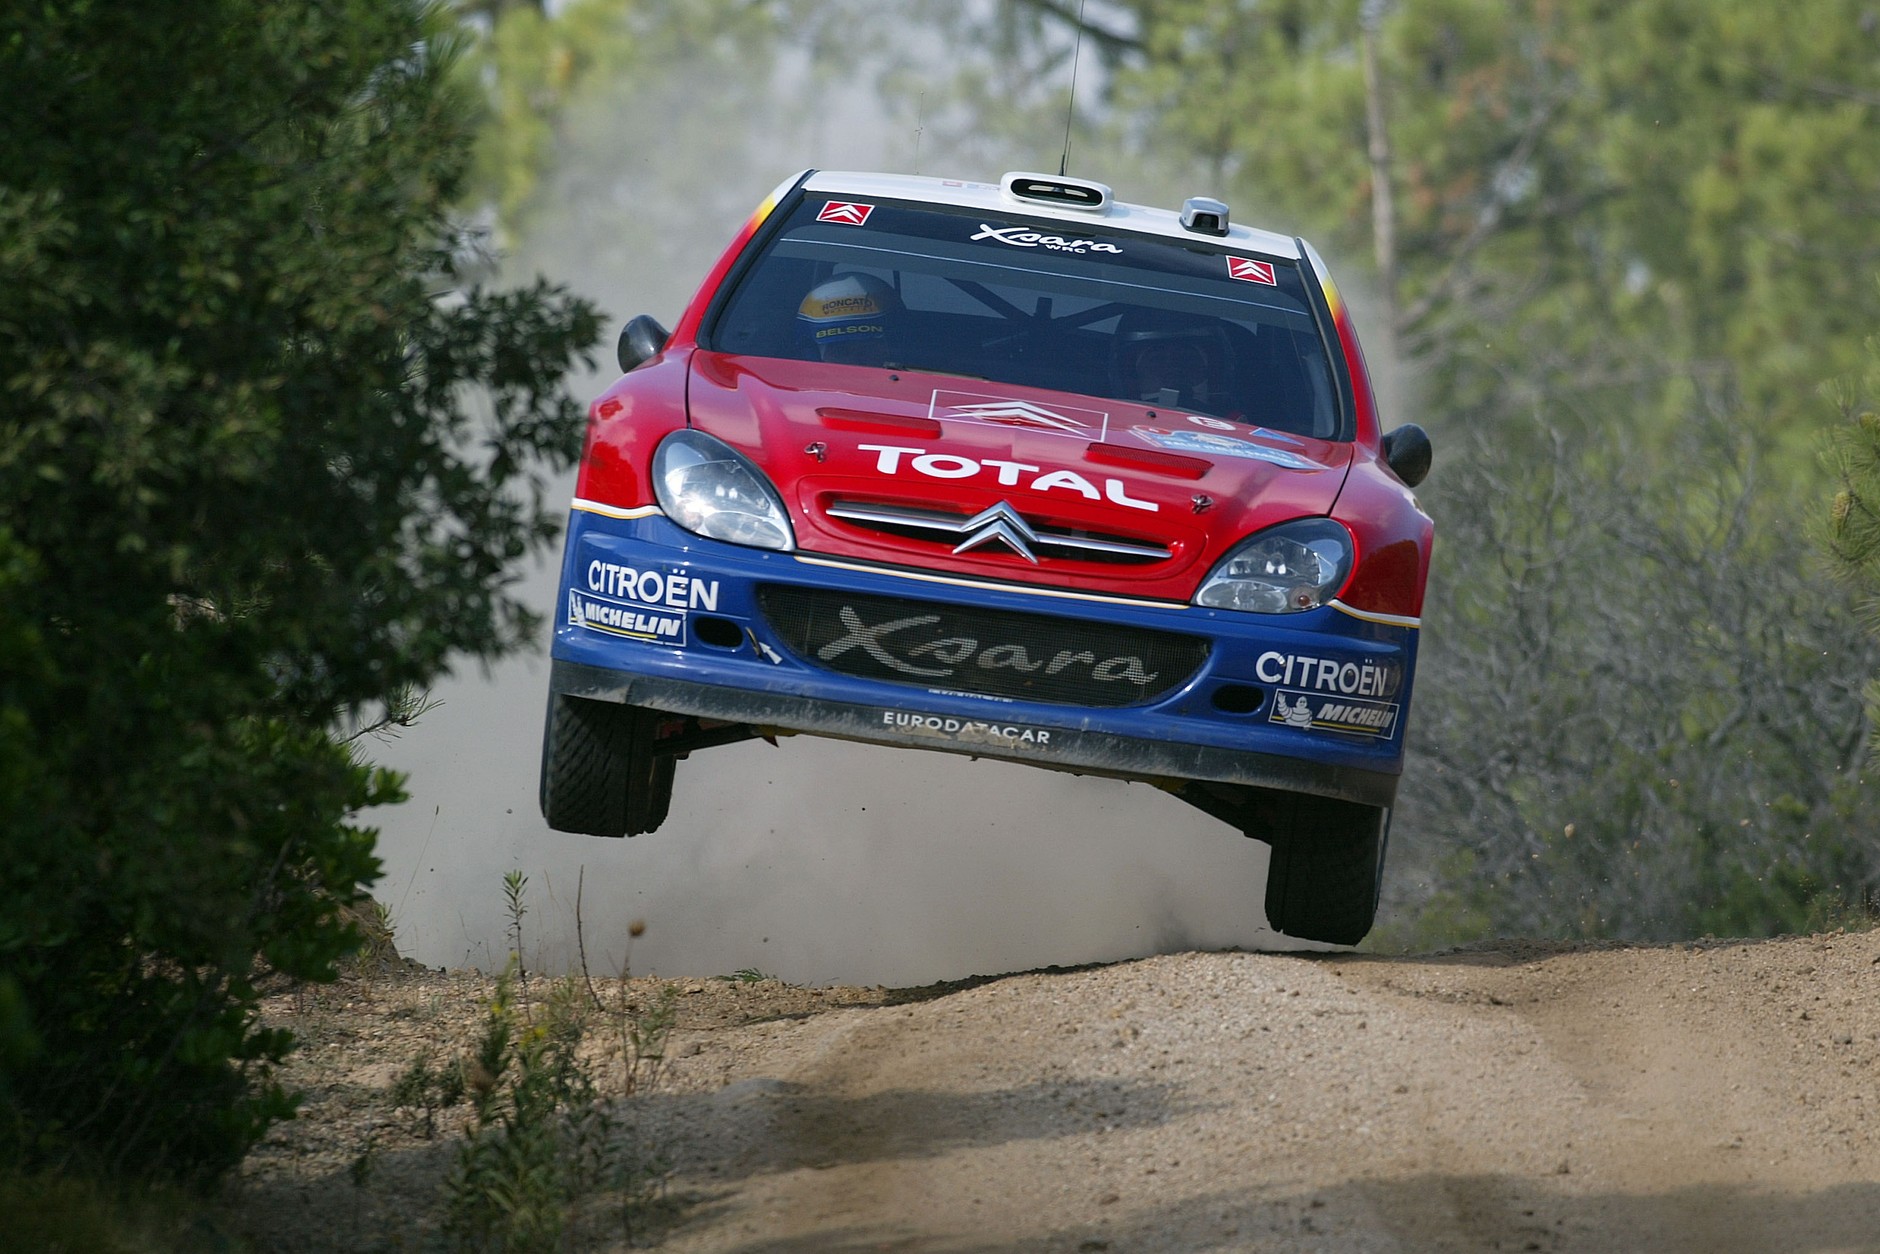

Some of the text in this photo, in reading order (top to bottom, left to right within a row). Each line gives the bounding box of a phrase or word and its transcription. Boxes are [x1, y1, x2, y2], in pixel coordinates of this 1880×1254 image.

[970, 223, 1124, 254] Xsara
[1045, 244, 1087, 254] WRC
[857, 444, 1160, 512] TOTAL
[588, 559, 720, 612] CITROËN
[584, 602, 682, 637] MICHELIN
[817, 604, 1159, 686] Xsara
[1255, 651, 1388, 697] CITROËN
[1316, 703, 1395, 728] MICHELIN
